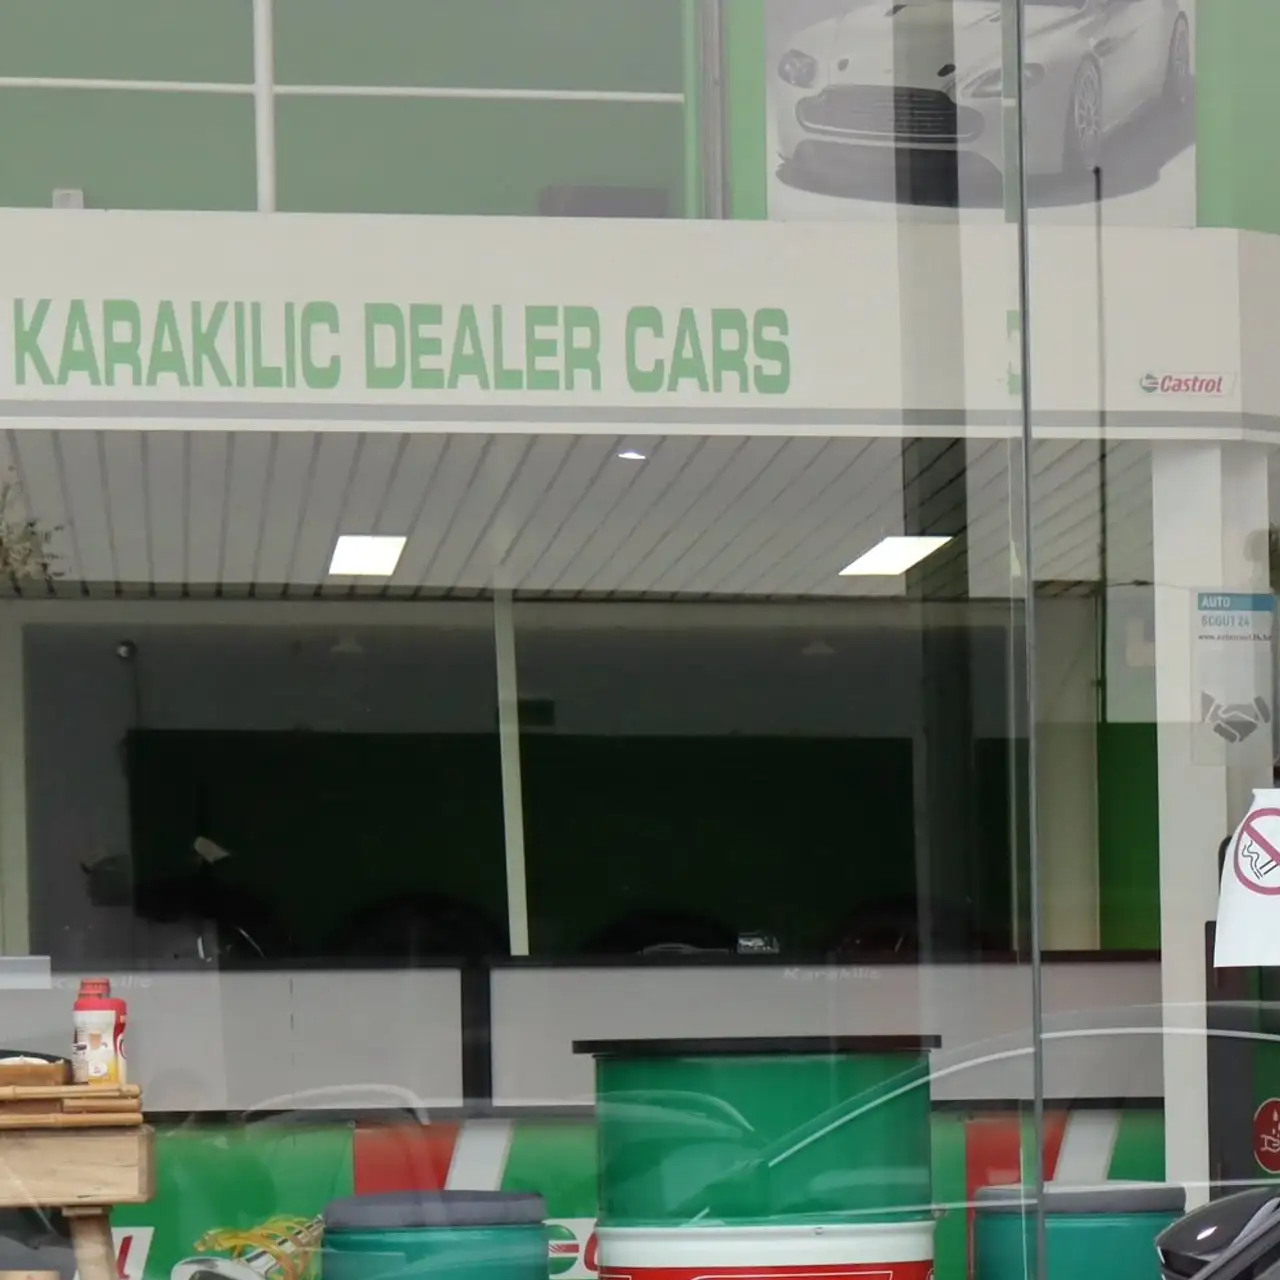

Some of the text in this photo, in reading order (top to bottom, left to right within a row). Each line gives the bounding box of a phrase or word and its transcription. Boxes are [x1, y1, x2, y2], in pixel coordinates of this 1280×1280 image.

[13, 297, 791, 395] KARAKILIC DEALER CARS
[1160, 374, 1223, 393] Castrol
[1201, 596, 1231, 608] AUTO
